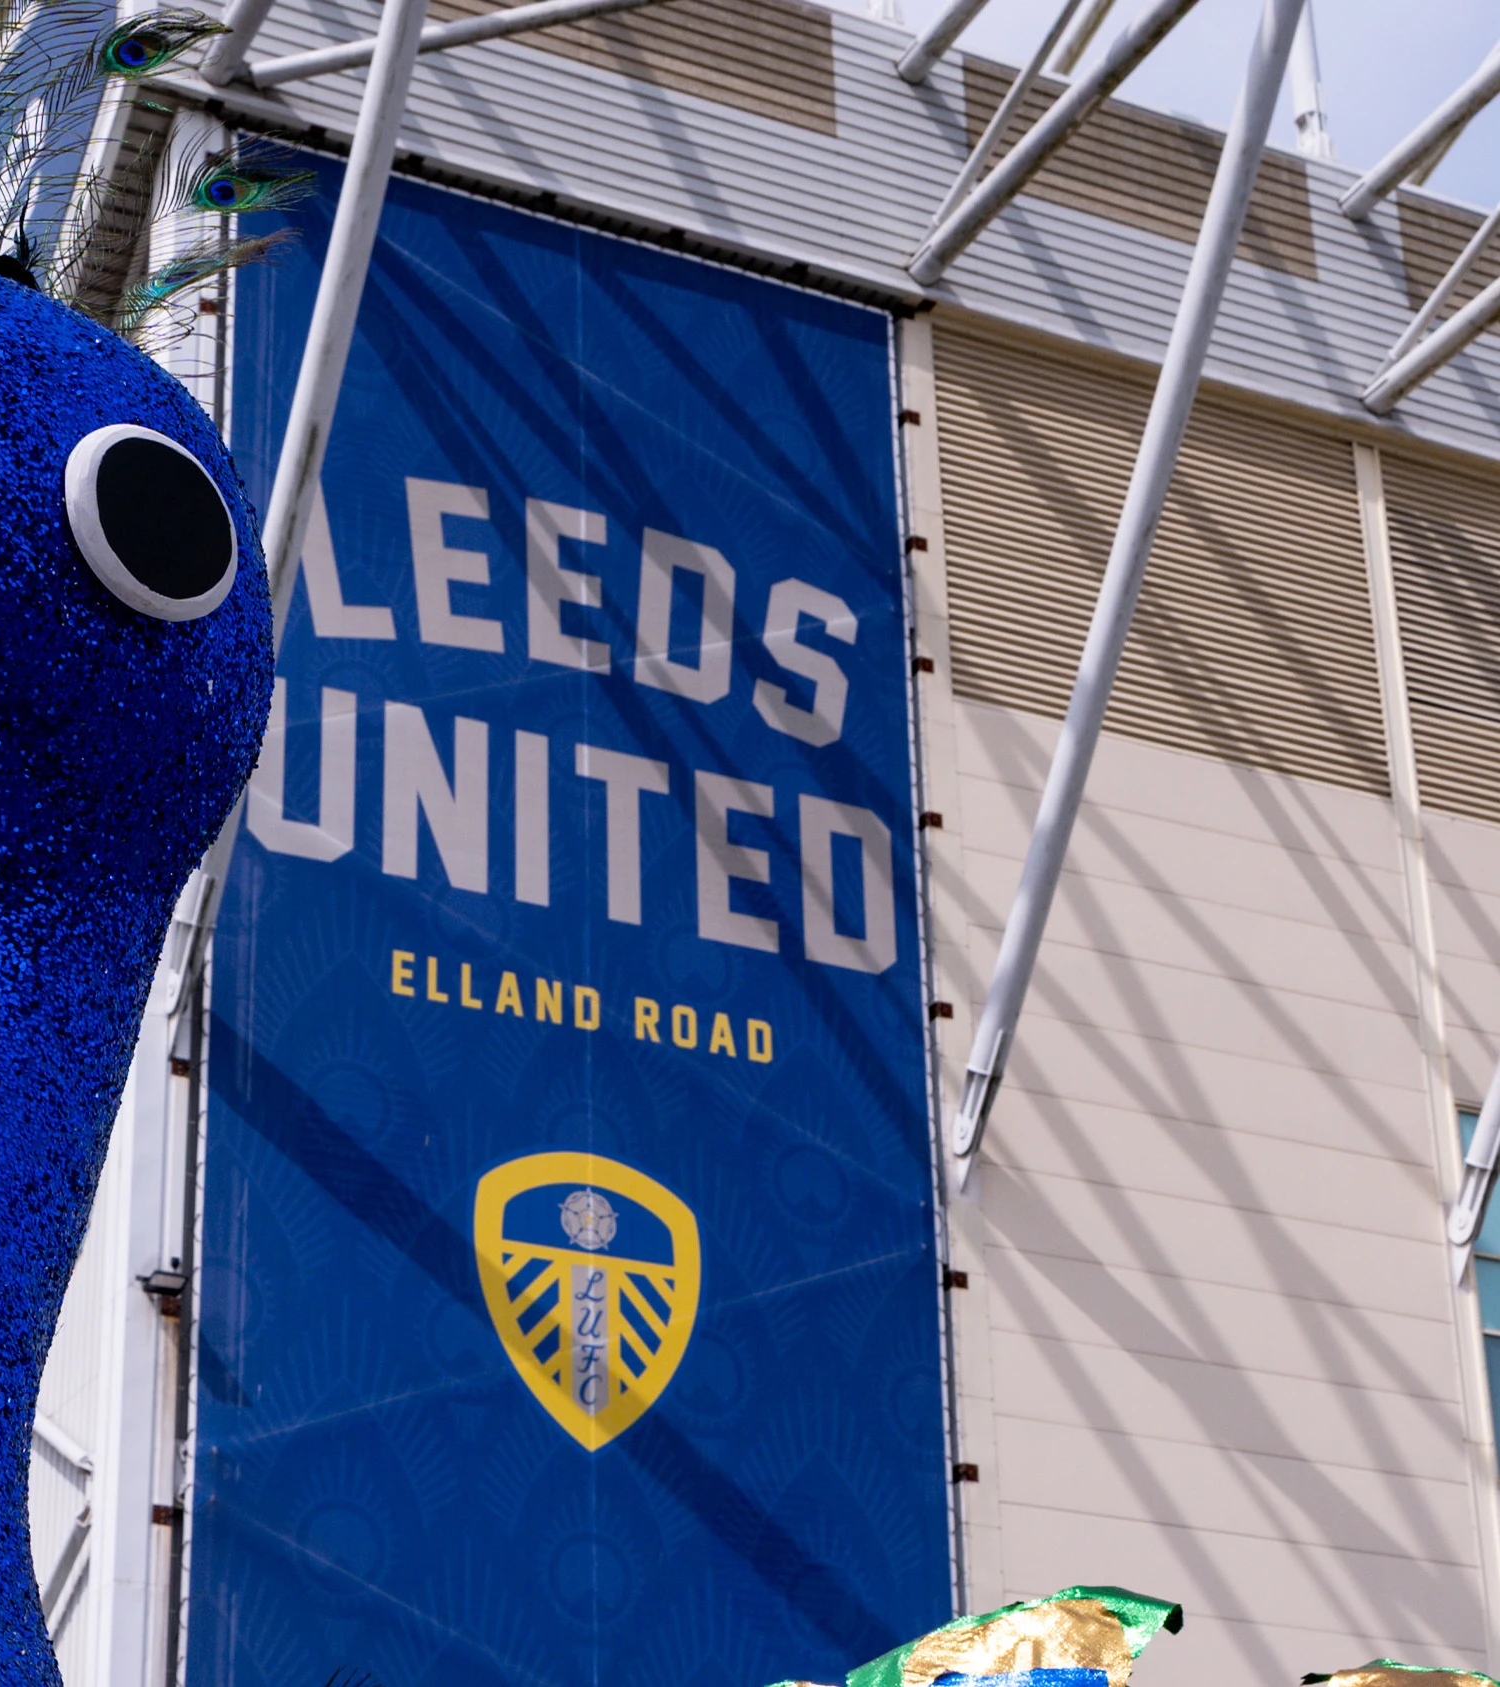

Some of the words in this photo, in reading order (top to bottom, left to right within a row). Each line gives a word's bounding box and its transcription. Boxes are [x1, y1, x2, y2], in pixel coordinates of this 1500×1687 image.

[300, 474, 859, 748] LEEDS
[246, 676, 898, 975] UNITED
[391, 949, 601, 1031] ELLAND
[634, 996, 774, 1064] ROAD
